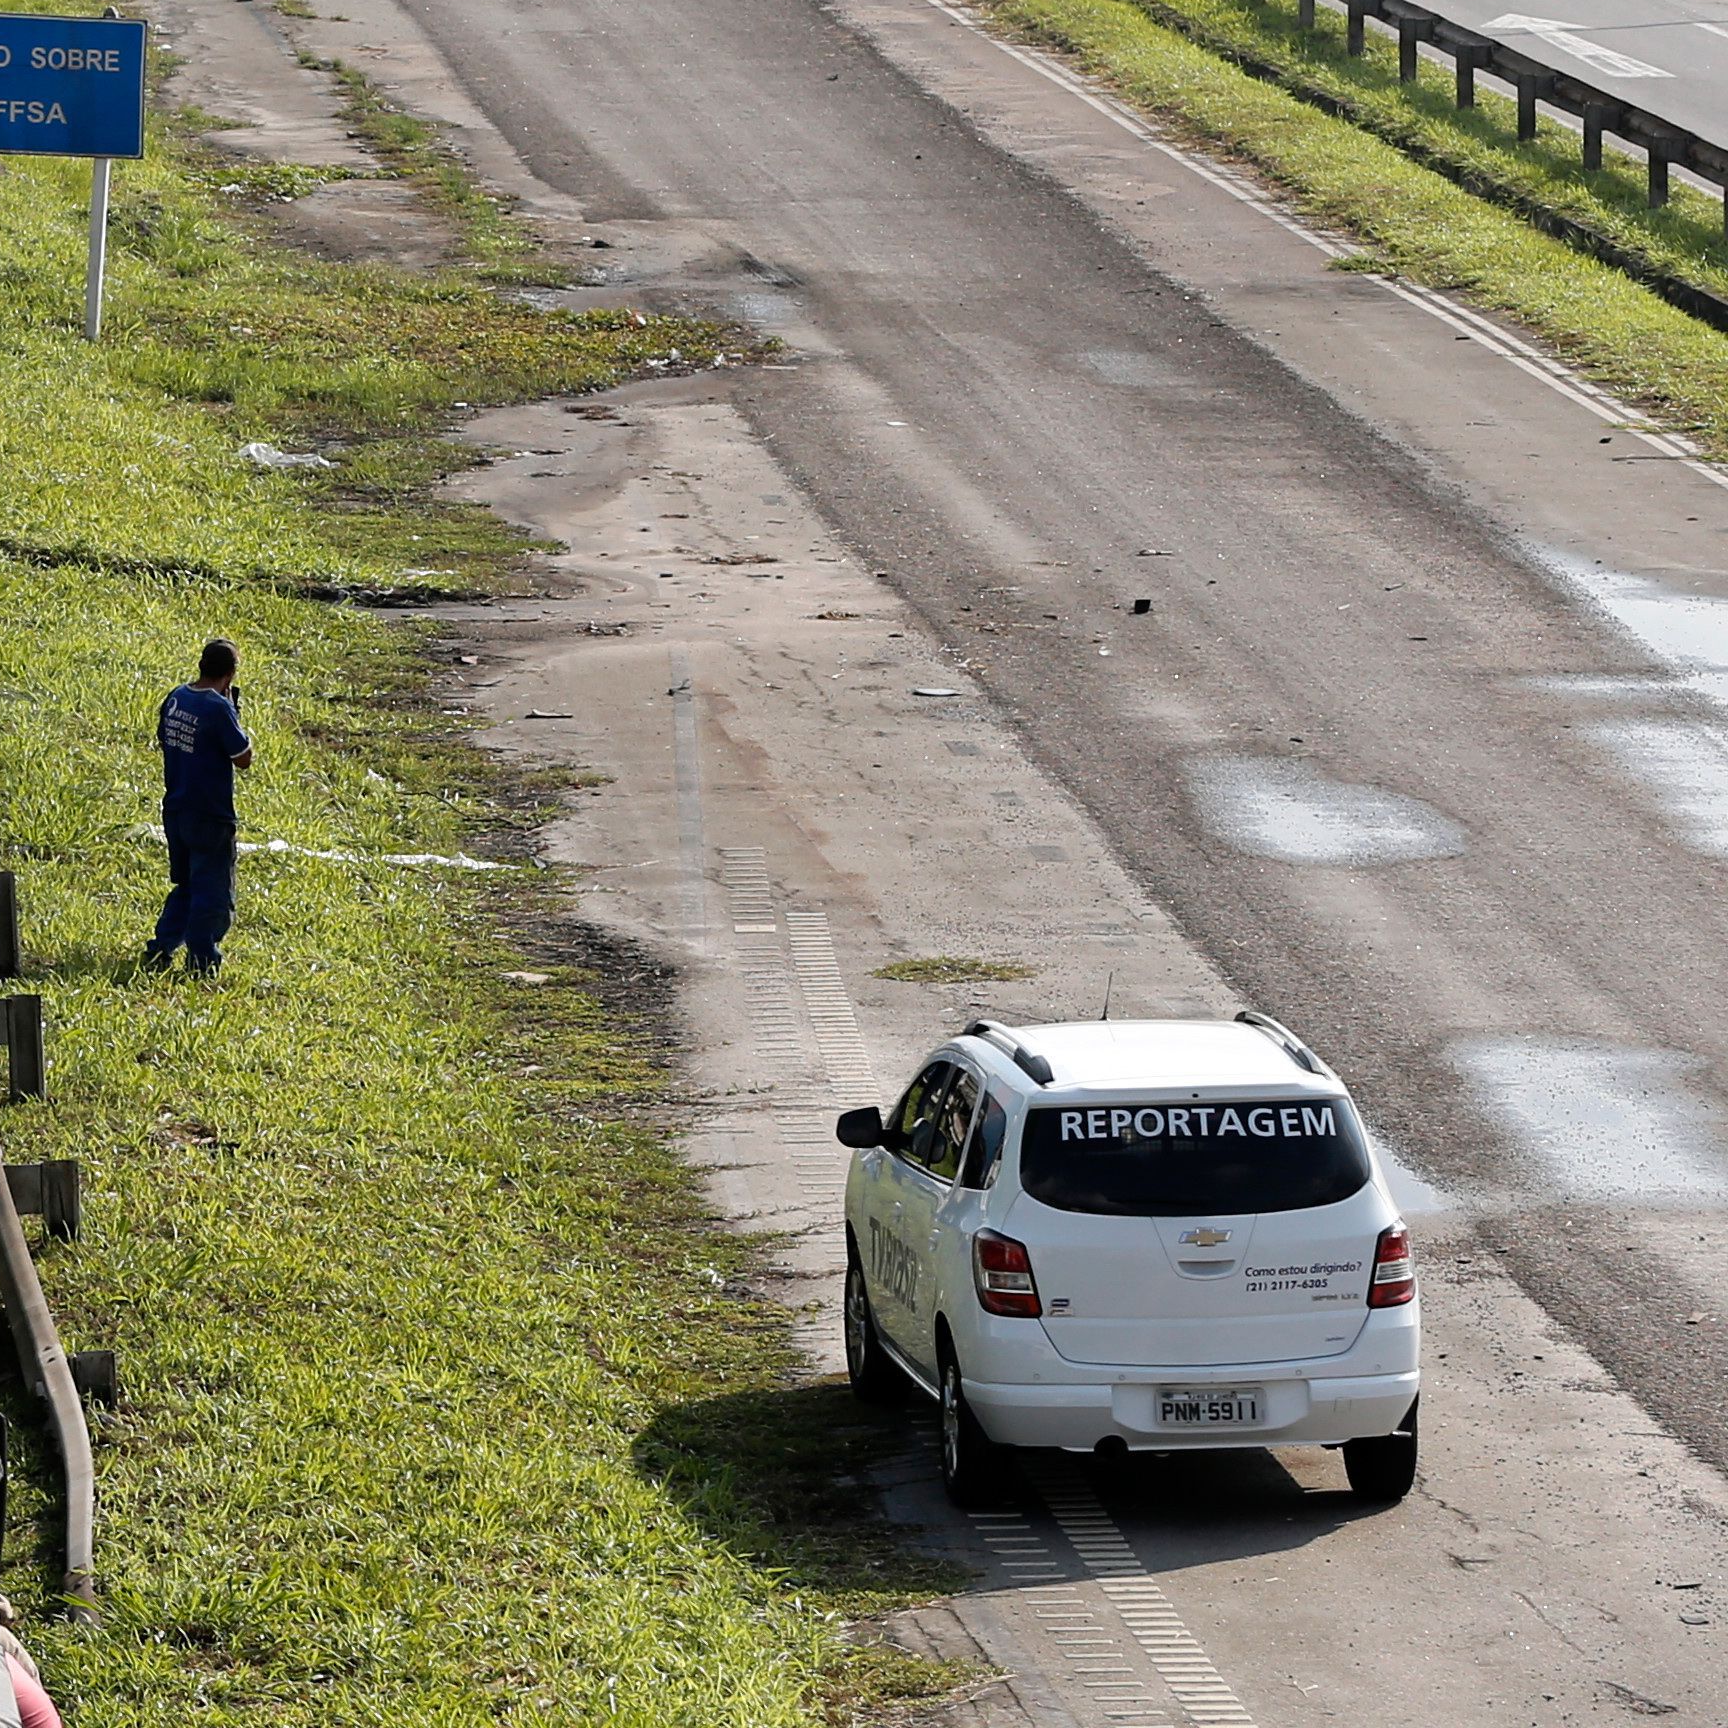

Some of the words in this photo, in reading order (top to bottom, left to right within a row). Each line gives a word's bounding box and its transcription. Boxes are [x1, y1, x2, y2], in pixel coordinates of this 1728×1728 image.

[30, 46, 120, 72] SOBRE
[1060, 1107, 1337, 1141] REPORTAGEM
[1245, 1267, 1276, 1277] Como
[1278, 1265, 1308, 1275] estou
[1310, 1261, 1363, 1276] dirigindo?
[1246, 1282, 1268, 1292] (21)
[1271, 1278, 1328, 1290] 2117-6305
